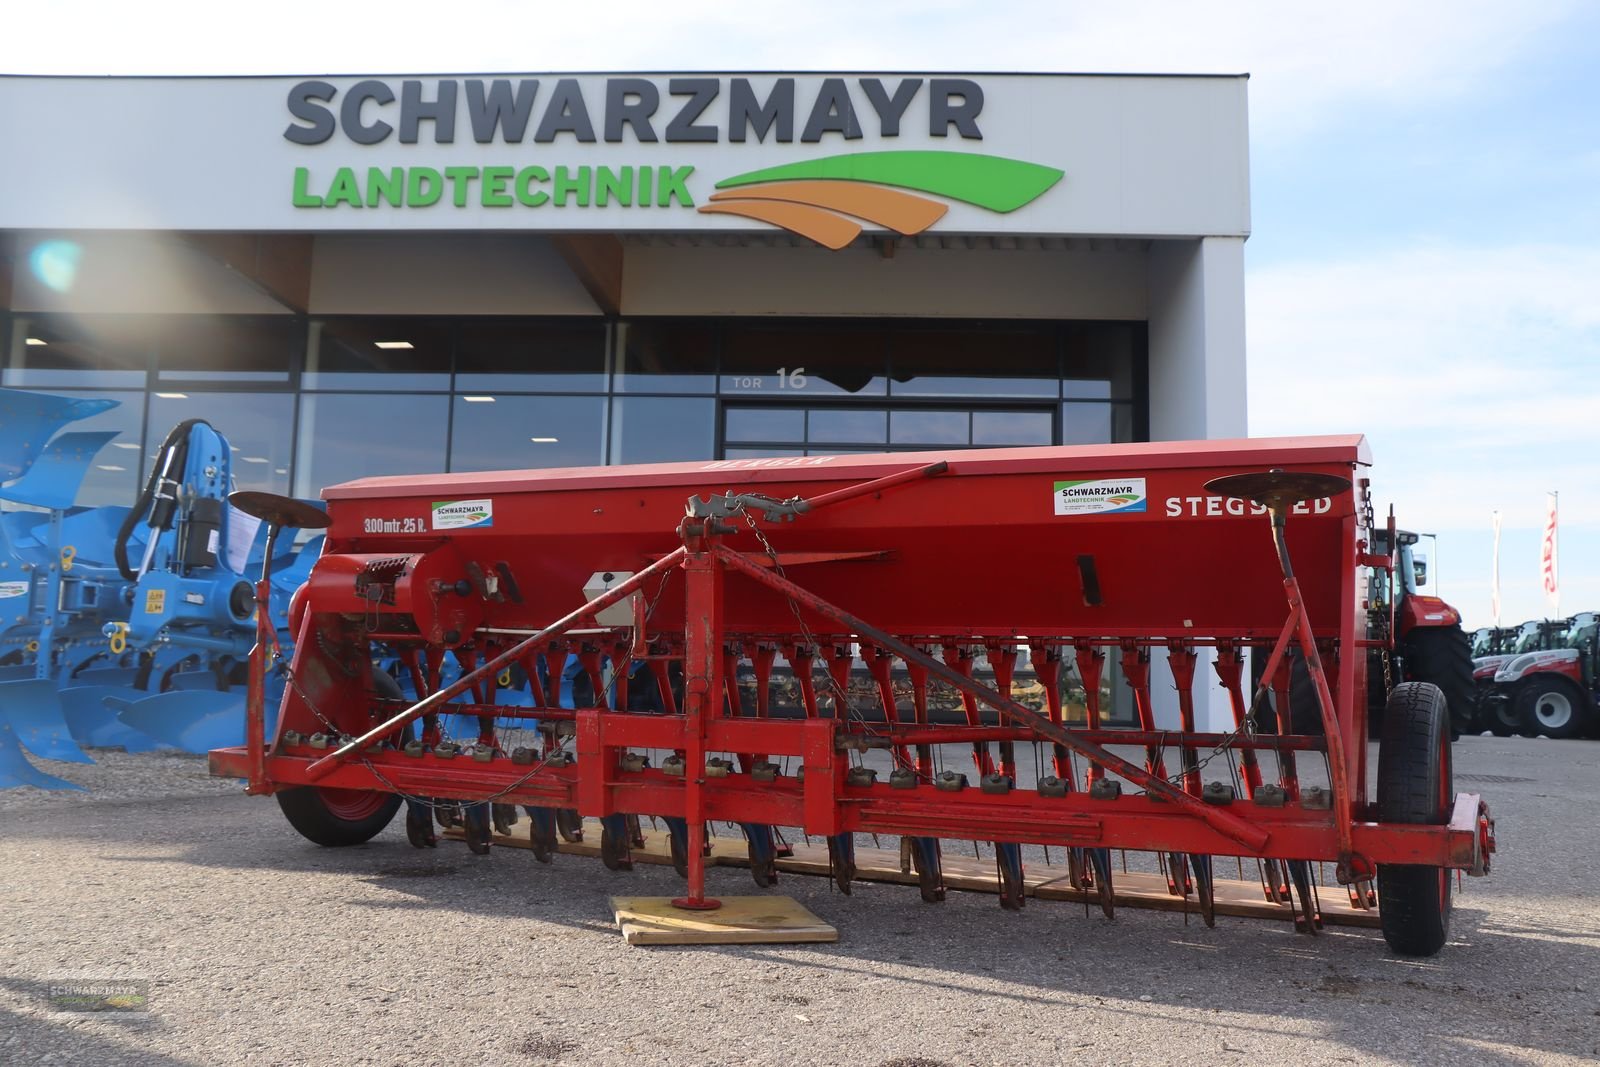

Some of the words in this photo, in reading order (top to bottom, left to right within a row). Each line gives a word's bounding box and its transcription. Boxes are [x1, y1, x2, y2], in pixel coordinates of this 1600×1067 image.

[283, 78, 985, 146] SCHWARZMAYR
[292, 165, 695, 209] LANDTECHNIK
[733, 378, 762, 388] TOR
[776, 367, 807, 389] 16
[1062, 486, 1133, 497] SCHWARZMAYR
[437, 506, 484, 515] SCHWARZMAYR
[1166, 496, 1332, 517] STEGSED
